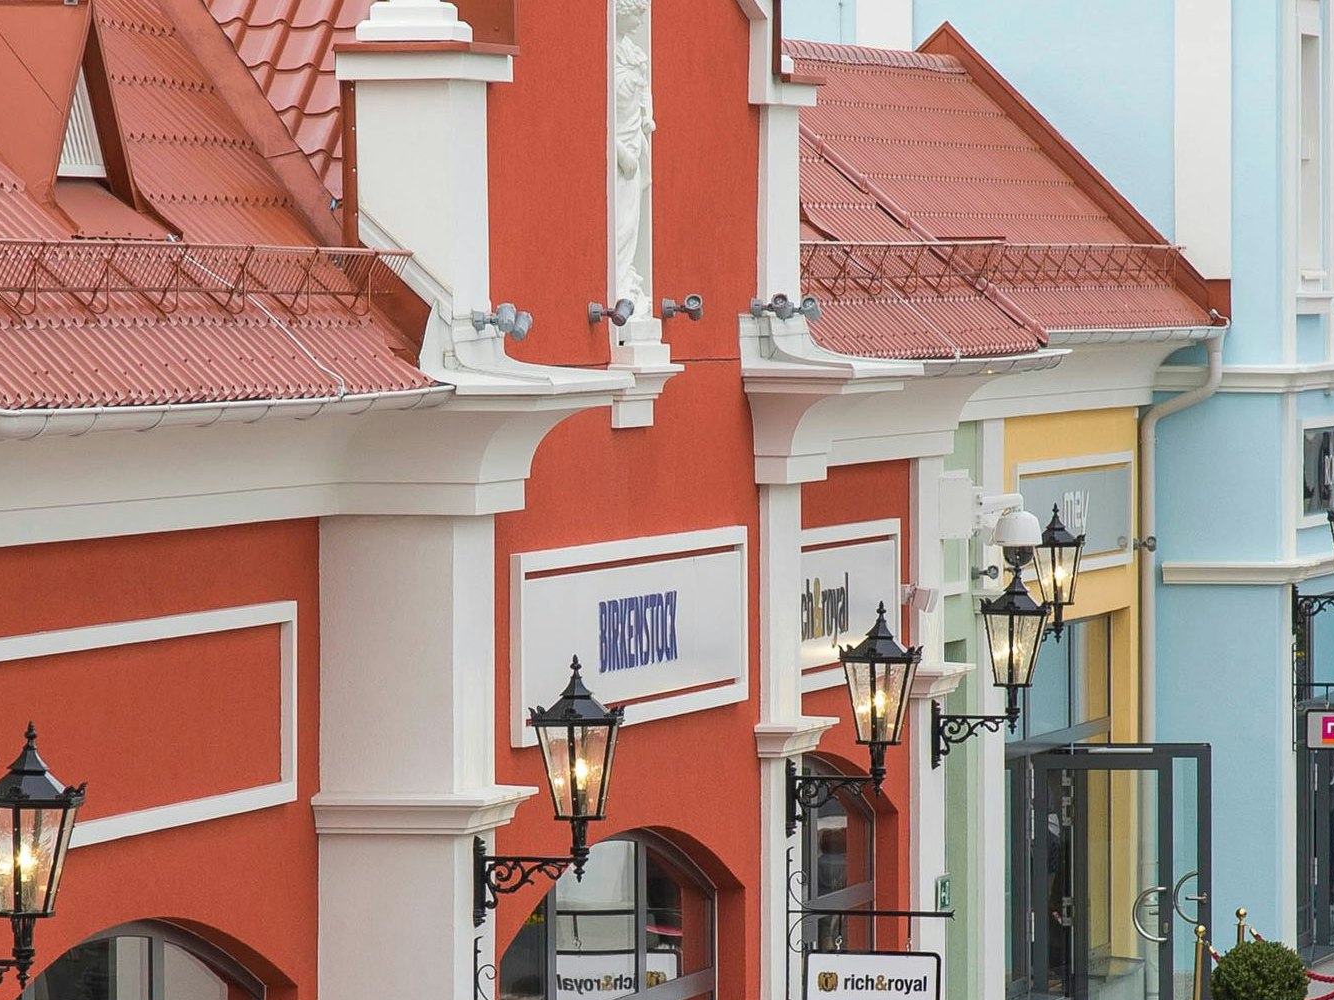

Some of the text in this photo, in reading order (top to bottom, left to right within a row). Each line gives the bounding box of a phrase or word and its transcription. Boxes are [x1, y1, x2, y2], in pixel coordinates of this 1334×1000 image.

[598, 590, 678, 673] BIRKENSTOCK
[801, 572, 849, 648] ch&royal
[843, 973, 927, 995] rich&royal
